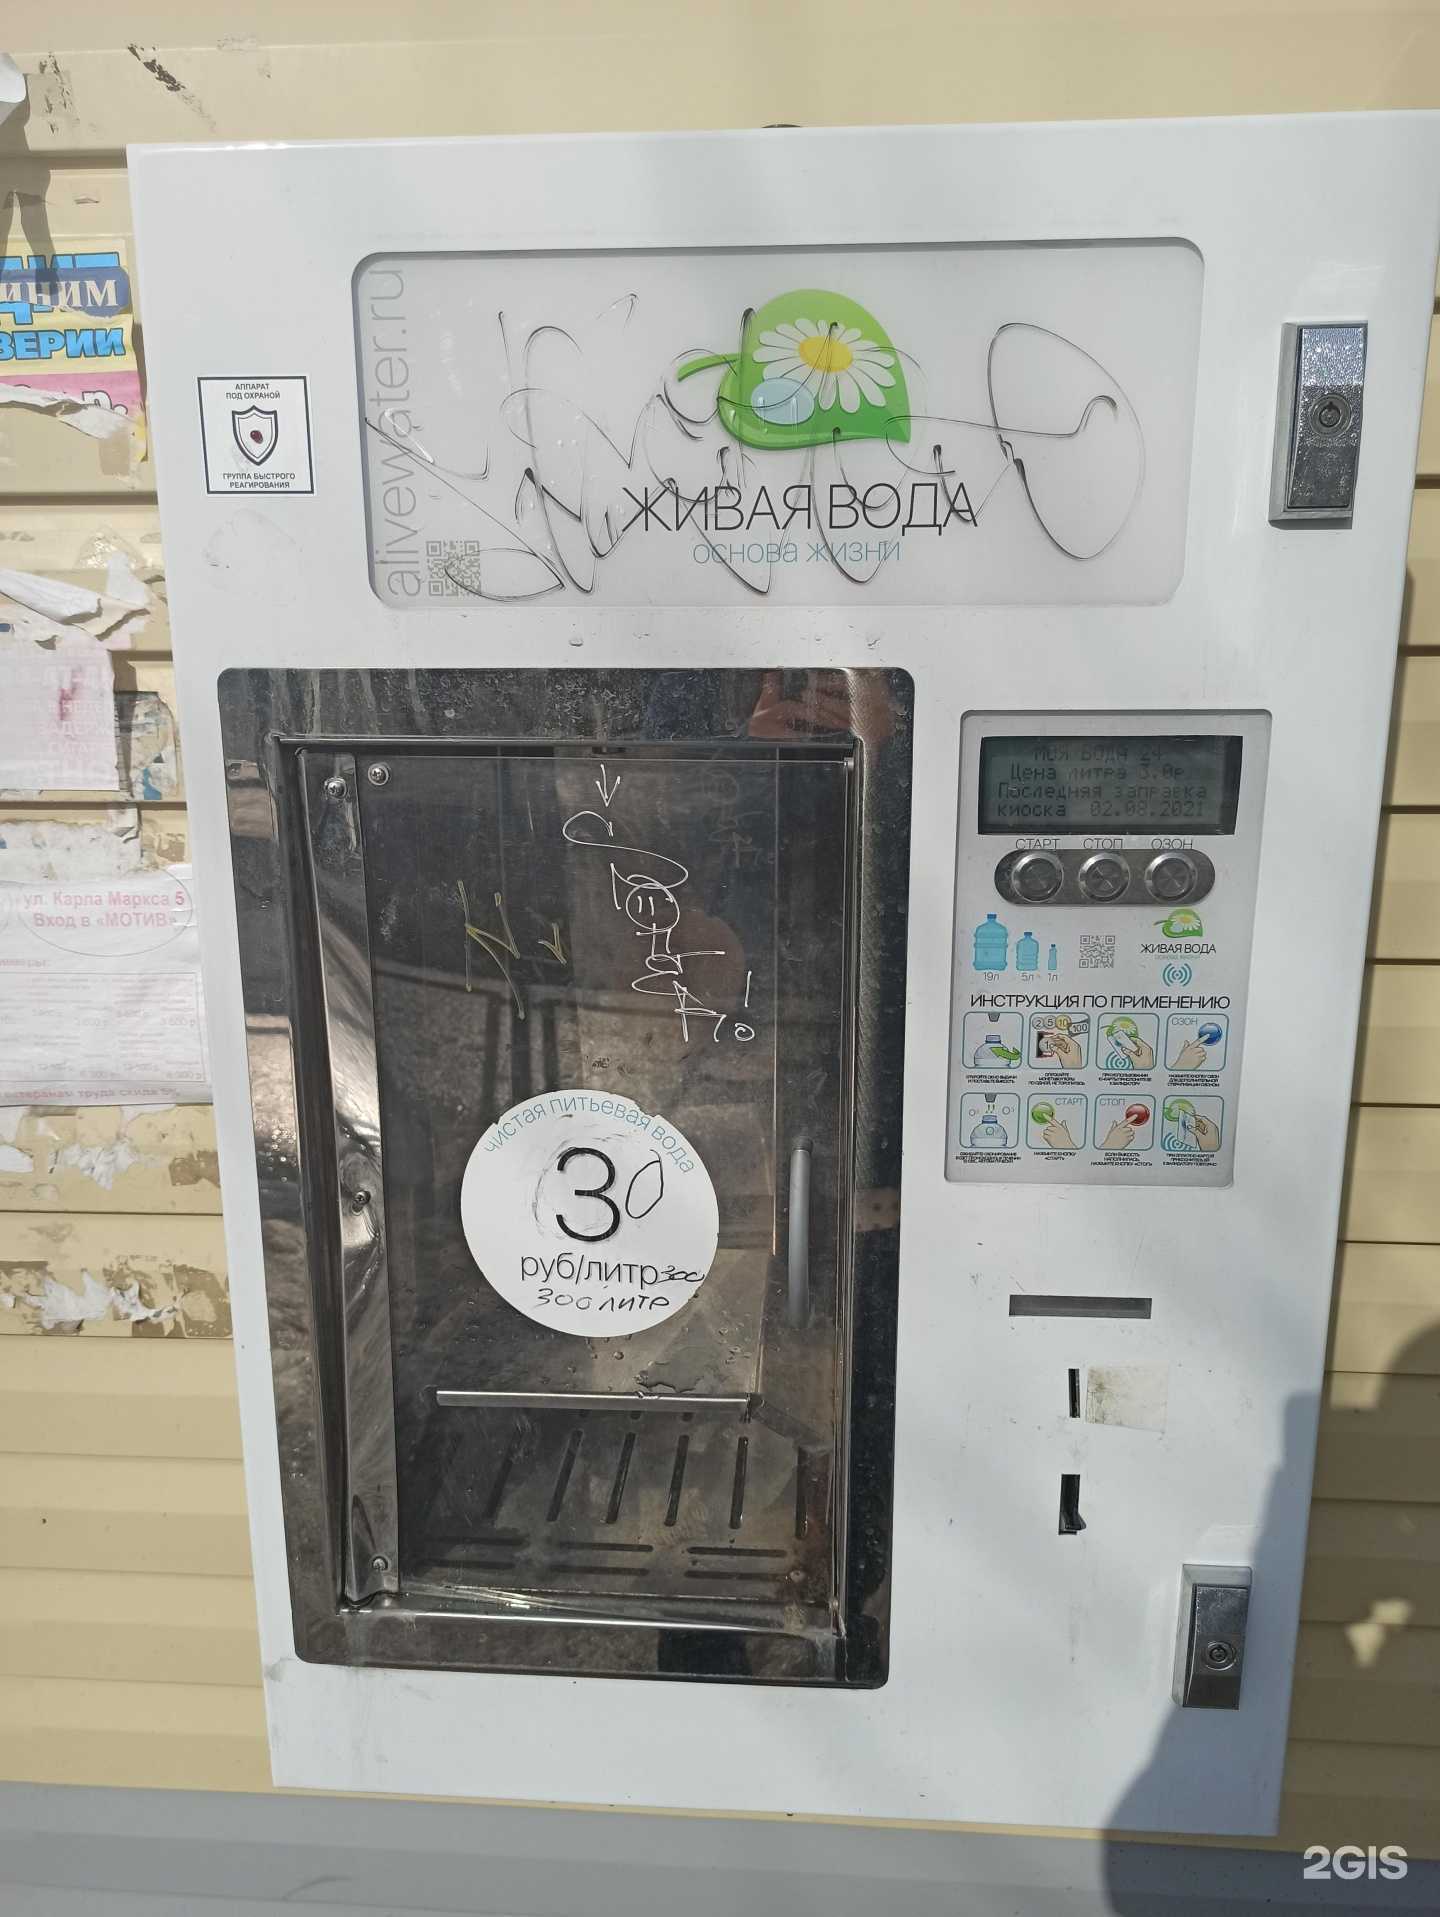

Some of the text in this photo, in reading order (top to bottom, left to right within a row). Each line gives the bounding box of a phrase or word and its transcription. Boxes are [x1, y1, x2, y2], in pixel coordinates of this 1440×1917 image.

[225, 390, 281, 400] ПОД ОХРАНОЙ
[622, 482, 978, 536] ЖИВАЯ ВОДА
[693, 541, 901, 564] основа жизни
[1010, 764, 1057, 781] Цена
[998, 783, 1102, 798] Последняя
[997, 803, 1067, 817] киоска
[1015, 838, 1060, 850] СТАРТ
[1083, 838, 1123, 849] СТОП
[1151, 838, 1193, 850] ОЗОН
[108, 890, 169, 908] Маркса
[175, 891, 185, 905] 5
[33, 913, 76, 929] Вход
[81, 917, 91, 927] в
[1140, 943, 1217, 955] ЖИВАЯ ВОДА
[984, 971, 1000, 981] 19л
[970, 994, 1230, 1009] ИНСТРУКЦИЯ ПО ПРИМЕНЕНИЮ
[1072, 1023, 1088, 1033] 100
[1171, 1016, 1198, 1026] ОЗОН
[1054, 1097, 1084, 1106] СТАРТ
[486, 1096, 695, 1173] чистая питьевая вода
[520, 1252, 658, 1290] руб/литр
